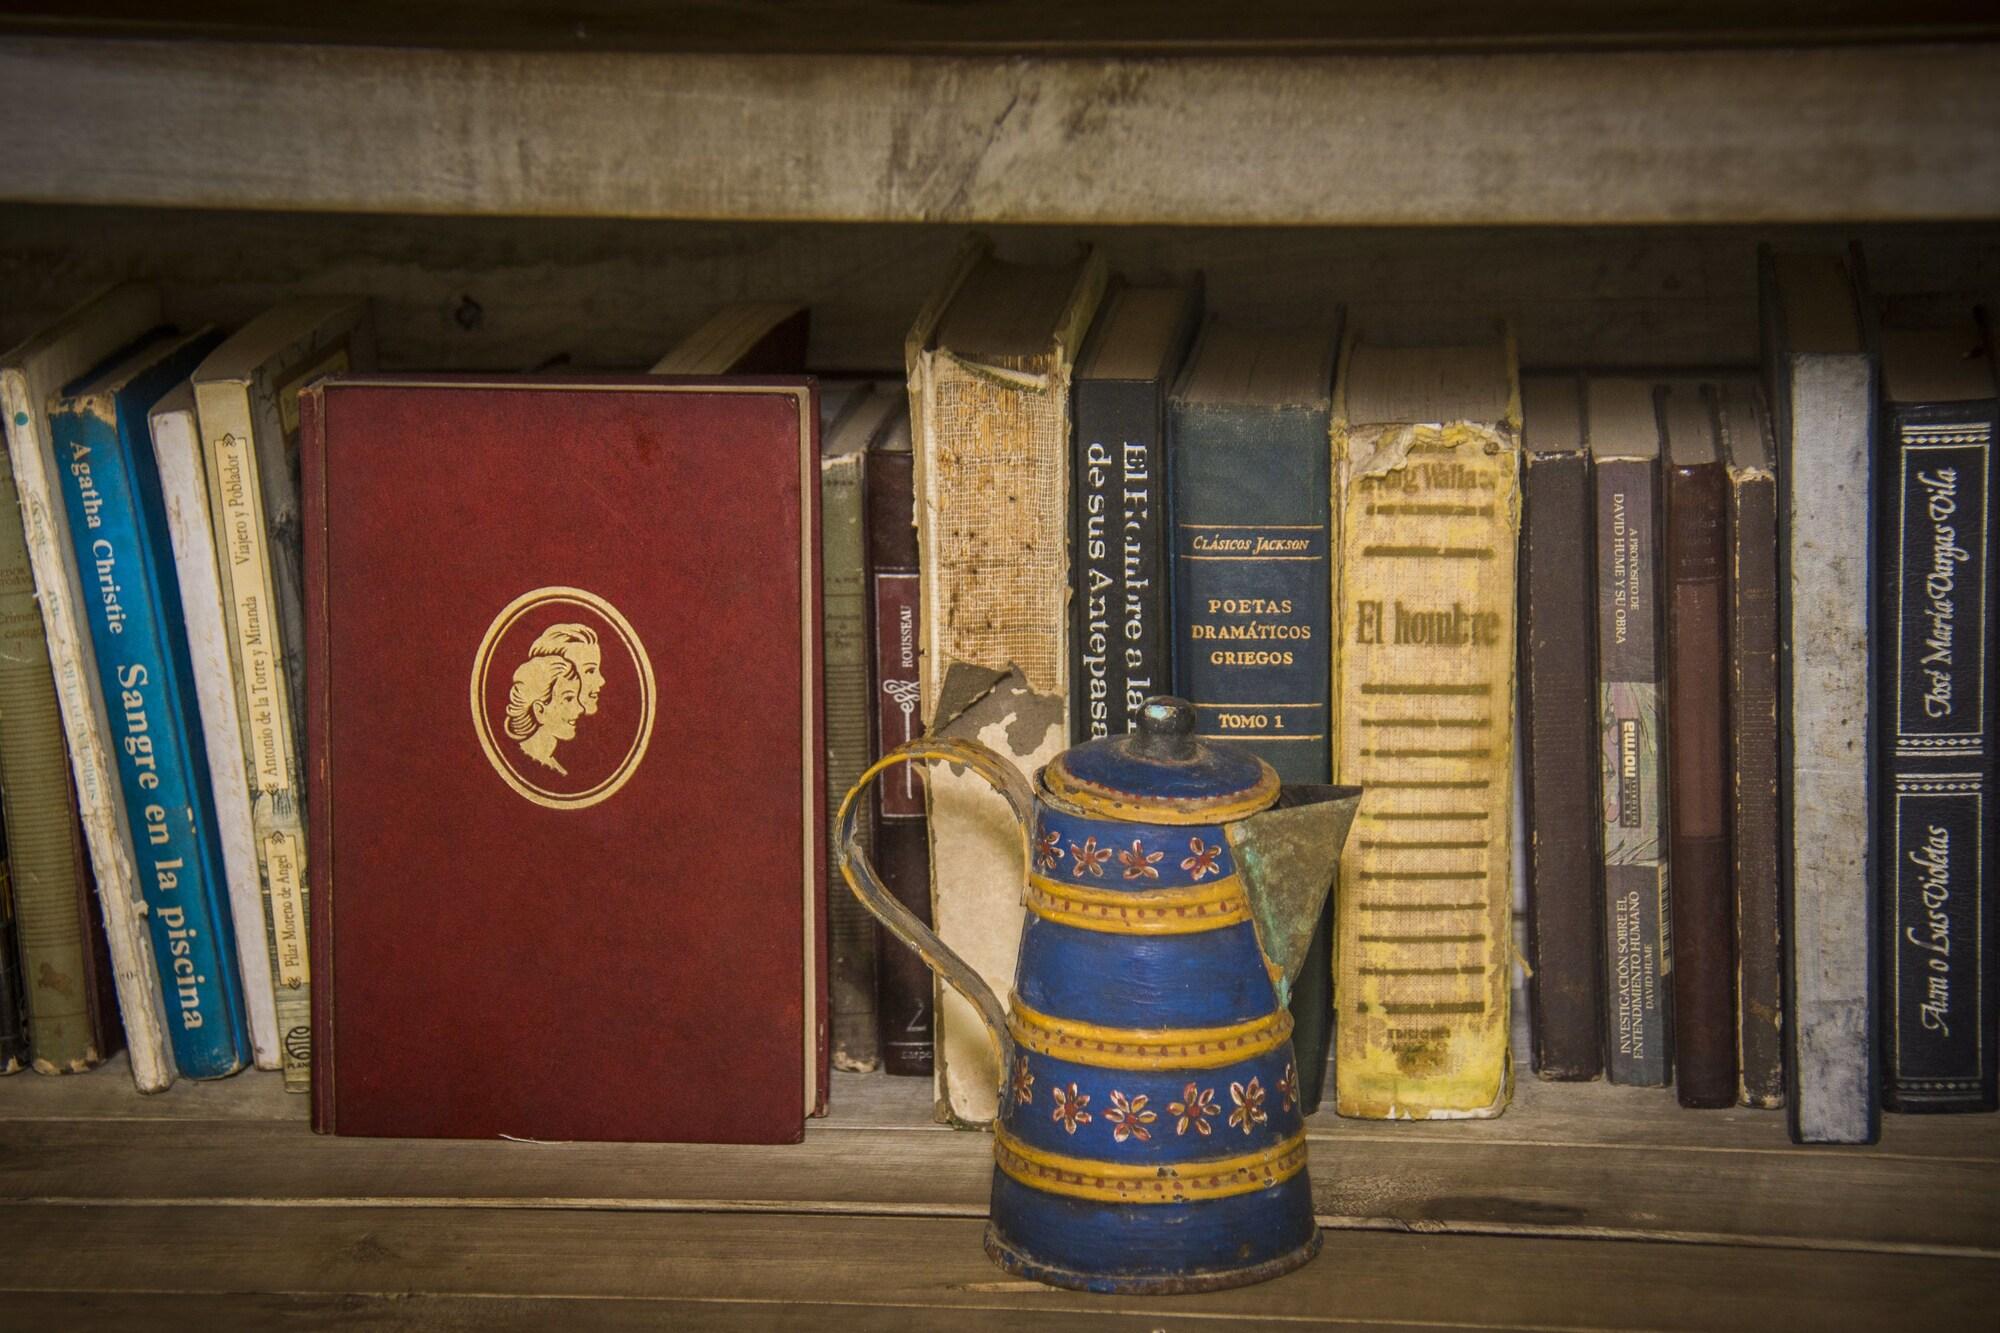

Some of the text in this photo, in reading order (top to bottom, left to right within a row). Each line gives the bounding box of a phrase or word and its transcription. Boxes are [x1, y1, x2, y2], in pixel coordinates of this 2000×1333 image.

[1124, 441, 1148, 482] El
[223, 454, 254, 566] Viajero y Poblador
[1629, 527, 1638, 536] A
[1083, 443, 1113, 741] de sus Antepasa
[1614, 493, 1627, 645] DAVID HUME Y SU OBRA
[1917, 466, 1970, 718] José María Vargas Vila
[241, 596, 262, 646] Miranda
[1208, 599, 1292, 614] POETAS
[1356, 599, 1500, 646] El hombre
[1630, 595, 1640, 611] DE
[901, 605, 913, 668] ROUSSEAU
[1191, 619, 1312, 640] DRAMÁTICOS
[252, 660, 268, 694] Torre
[1125, 648, 1143, 668] a
[1210, 650, 1294, 666] GRIEGOS
[254, 696, 270, 711] la
[256, 711, 271, 725] de
[1126, 677, 1150, 712] la
[70, 441, 206, 1030] Agatha Christie Sangre en la piscina
[1218, 713, 1285, 729] TOMO 1
[257, 727, 278, 777] Antonio
[1624, 720, 1636, 778] norma
[1909, 825, 1950, 908] Violetas
[276, 855, 299, 969] Pilar Moreno de Angel
[1906, 910, 1950, 957] Las
[1616, 897, 1631, 1053] INVESTIGACIÓN SOBRE EL
[1629, 891, 1644, 1060] ENTENDIMIENTO HUMANO
[1644, 943, 1654, 1010] DAVID HUME
[1929, 958, 1950, 972] o
[905, 997, 927, 1032] 2
